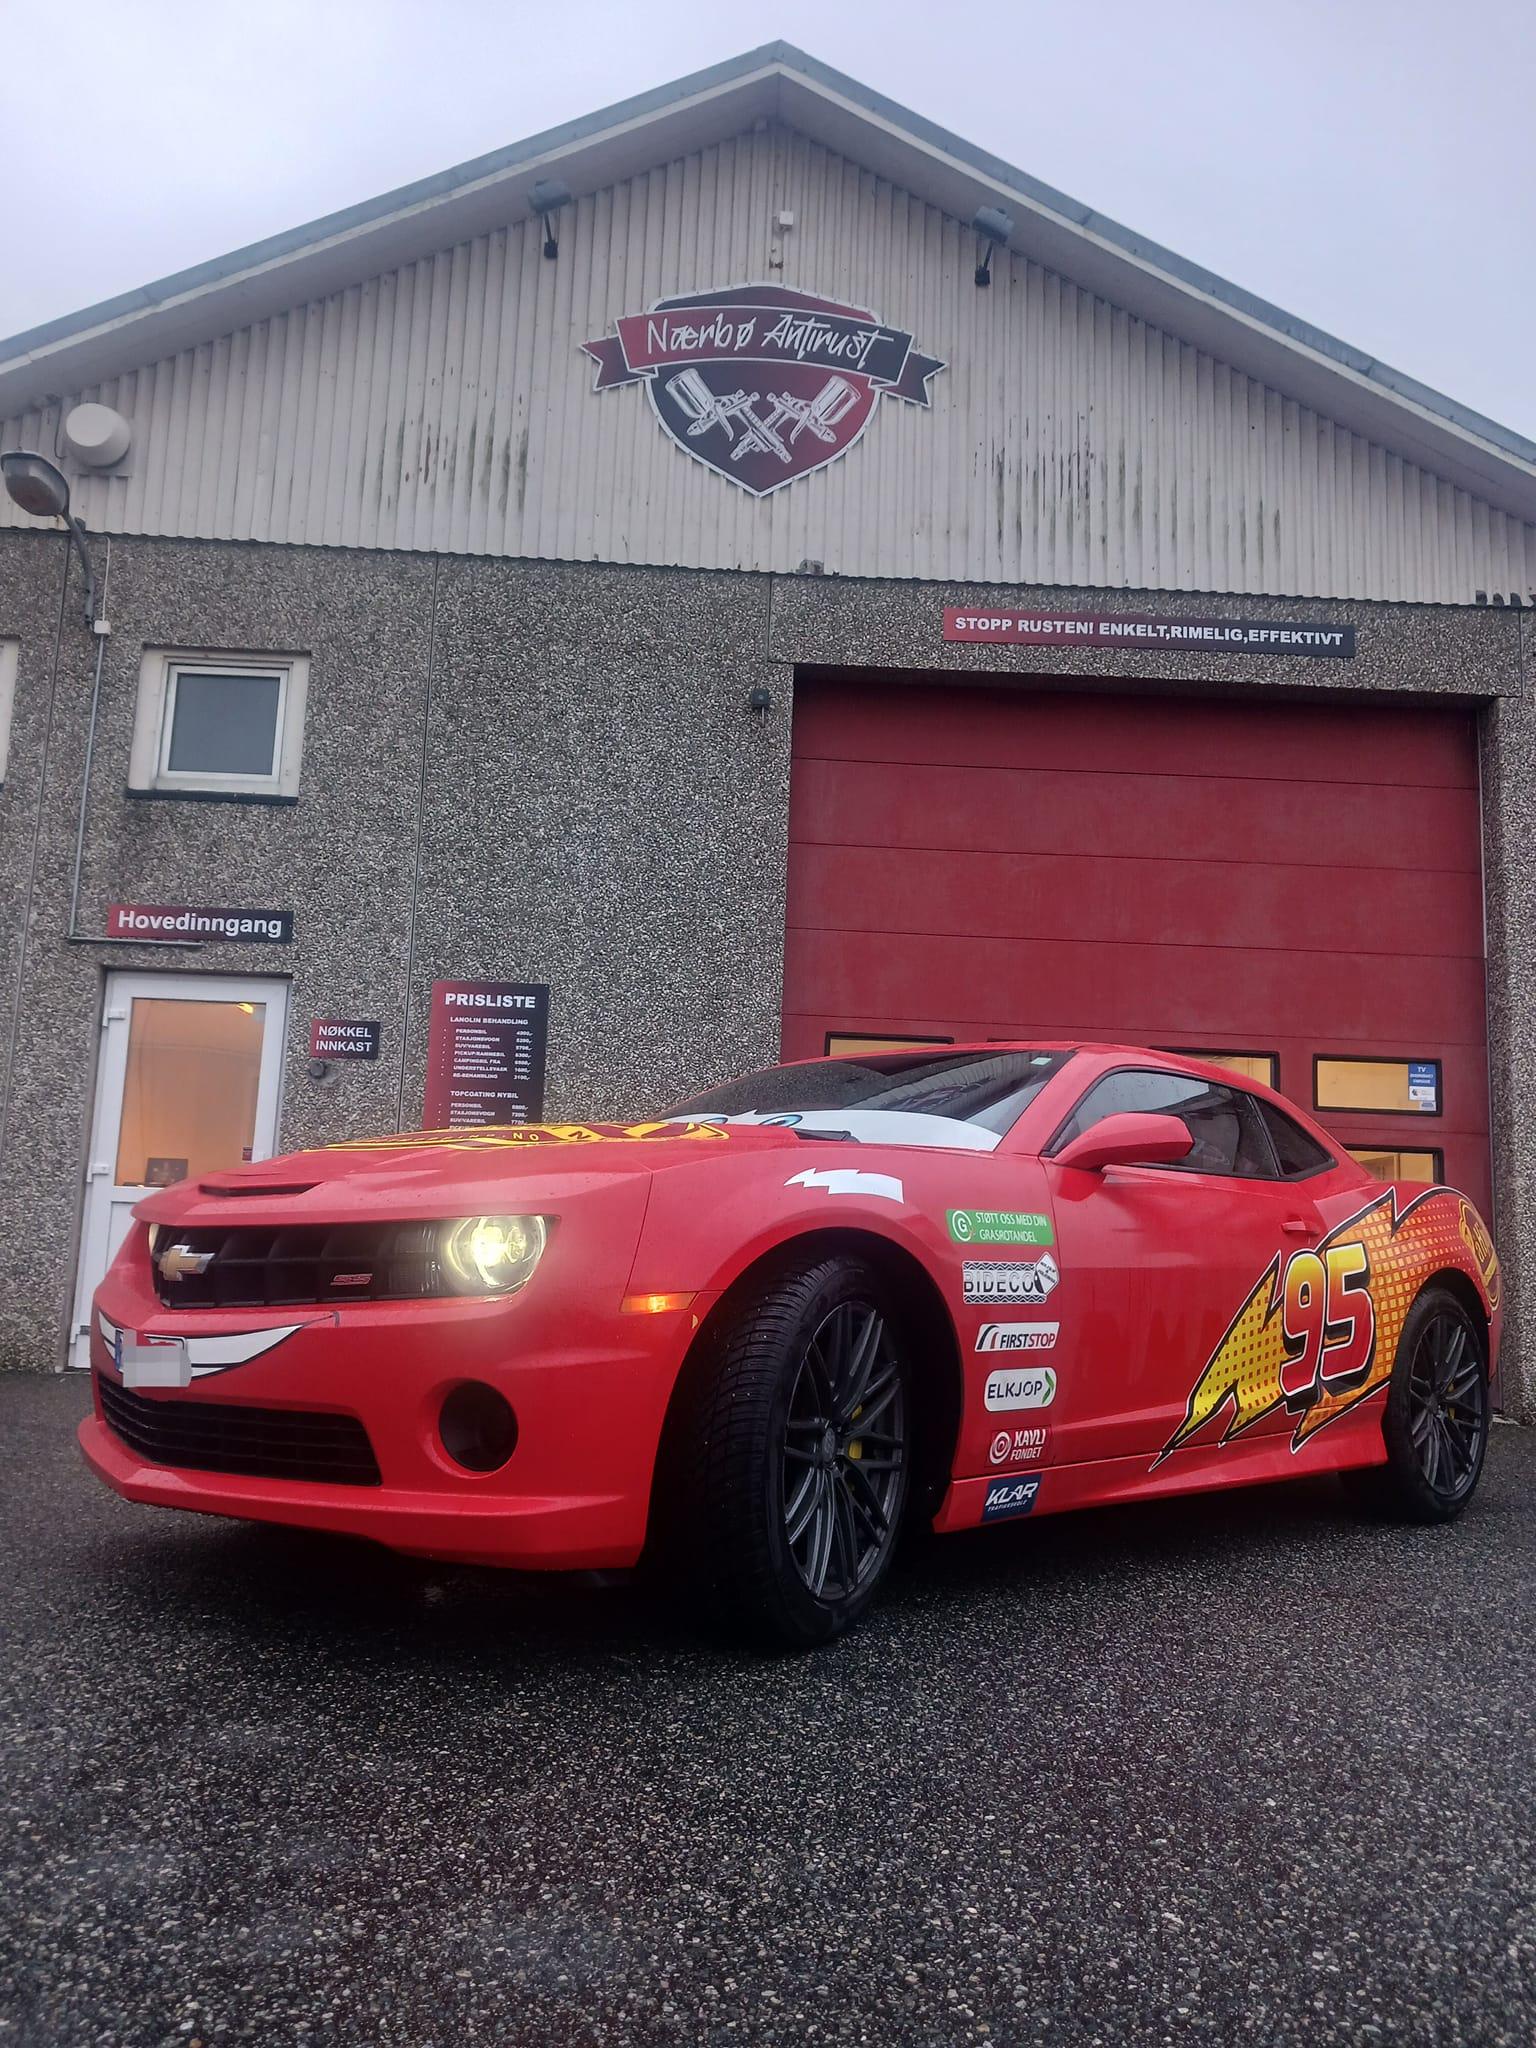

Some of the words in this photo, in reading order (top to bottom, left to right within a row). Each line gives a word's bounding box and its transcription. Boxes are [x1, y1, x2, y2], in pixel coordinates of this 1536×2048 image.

[647, 312, 757, 354] Nærbø
[761, 313, 894, 370] Antirust
[955, 617, 1013, 631] STOPP
[1018, 619, 1094, 635] RUSTEN!
[118, 909, 283, 938] Hovedinngang
[445, 993, 536, 1009] PRISLISTE
[450, 1016, 481, 1024] LANOLIN
[483, 1018, 529, 1026] BEHANDLING
[318, 1026, 373, 1039] NØKKEL
[315, 1040, 373, 1053] INNKAST
[450, 1090, 496, 1098] TOPCOATING
[1000, 1214, 1015, 1225] OSS
[1016, 1215, 1033, 1226] MED
[1034, 1216, 1047, 1227] DIN
[964, 1272, 1034, 1293] BIDECO
[1280, 1242, 1374, 1397] 95
[1014, 1429, 1046, 1447] KAVLI
[1010, 1447, 1042, 1461] FONDET
[985, 1482, 1038, 1506] KLAR
